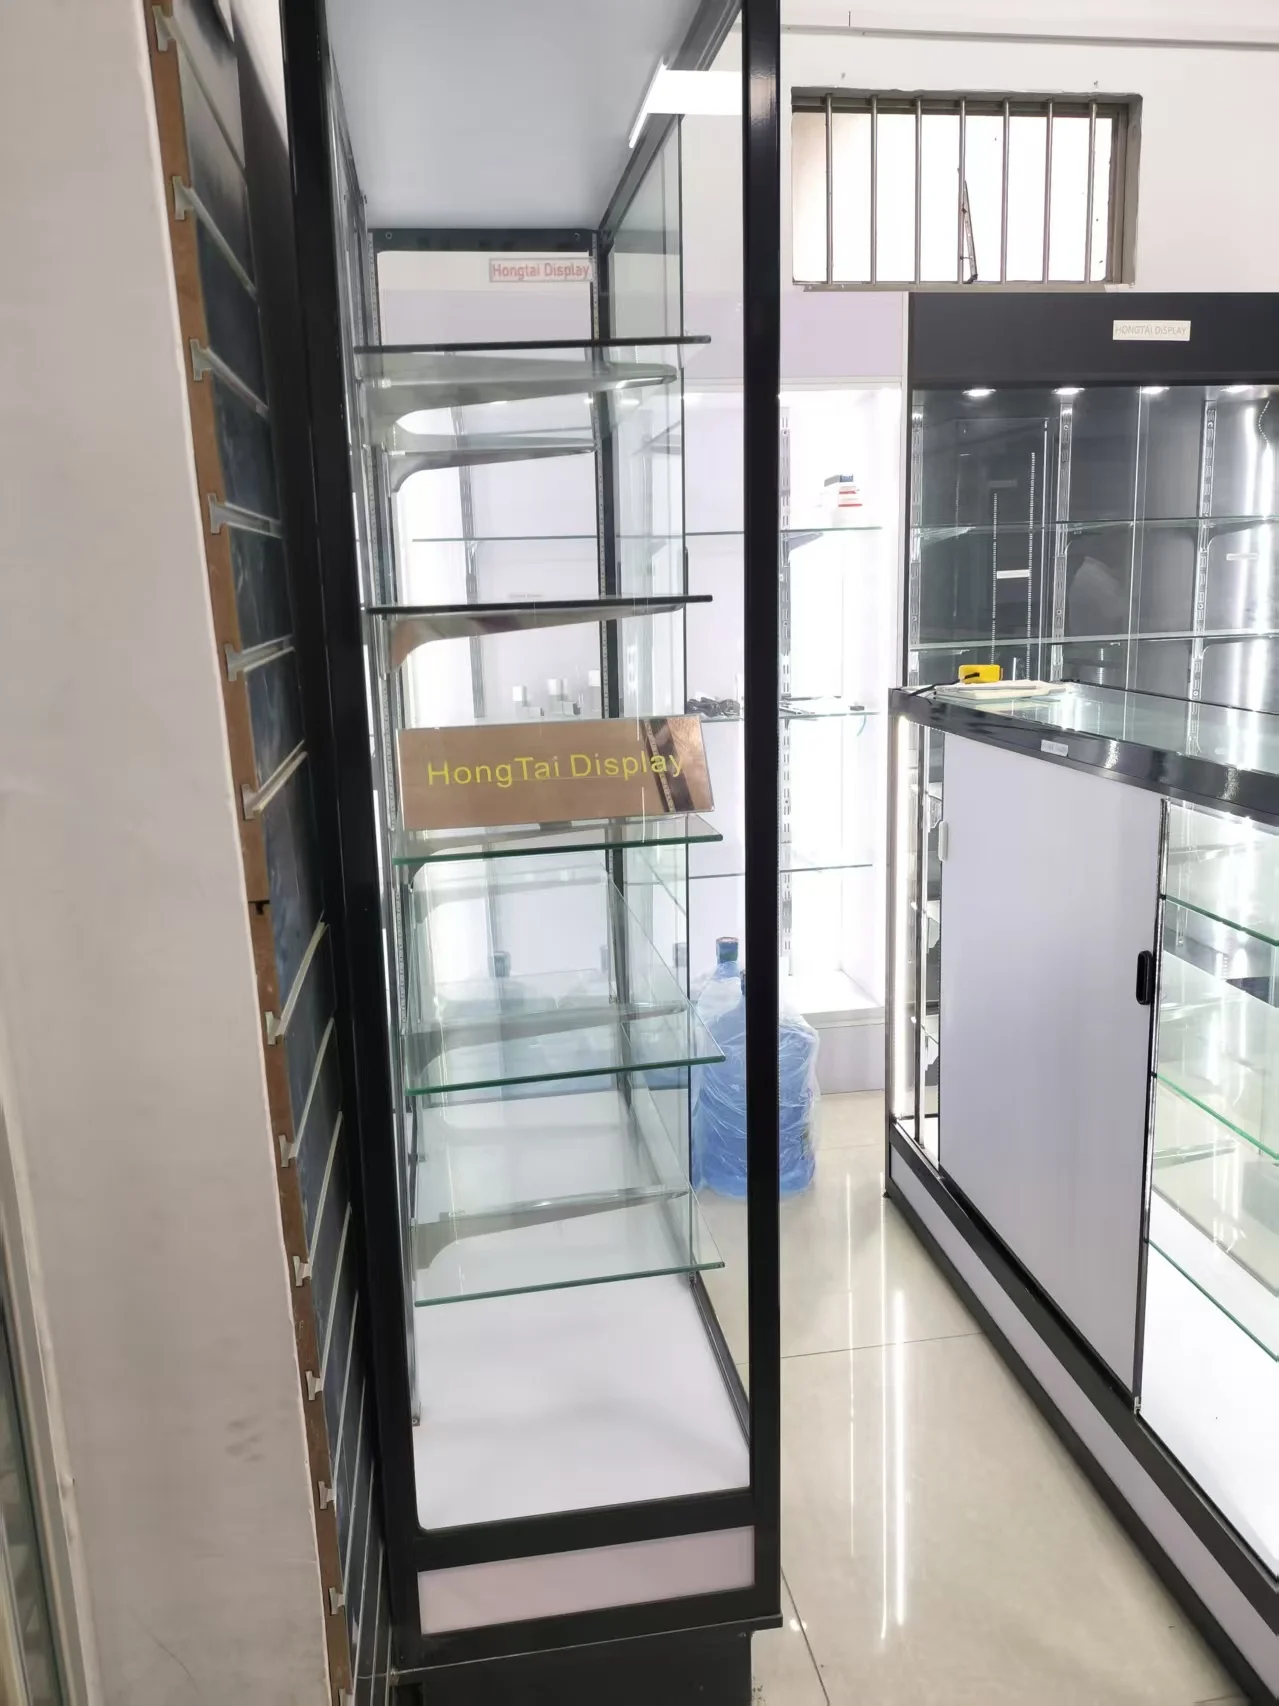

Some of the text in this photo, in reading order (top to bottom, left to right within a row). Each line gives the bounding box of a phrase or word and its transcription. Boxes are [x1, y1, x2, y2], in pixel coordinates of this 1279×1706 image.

[493, 262, 590, 281] Hongtai Display
[1115, 324, 1187, 335] HONGTAI DISPLAY
[427, 750, 683, 788] HongTai Display
